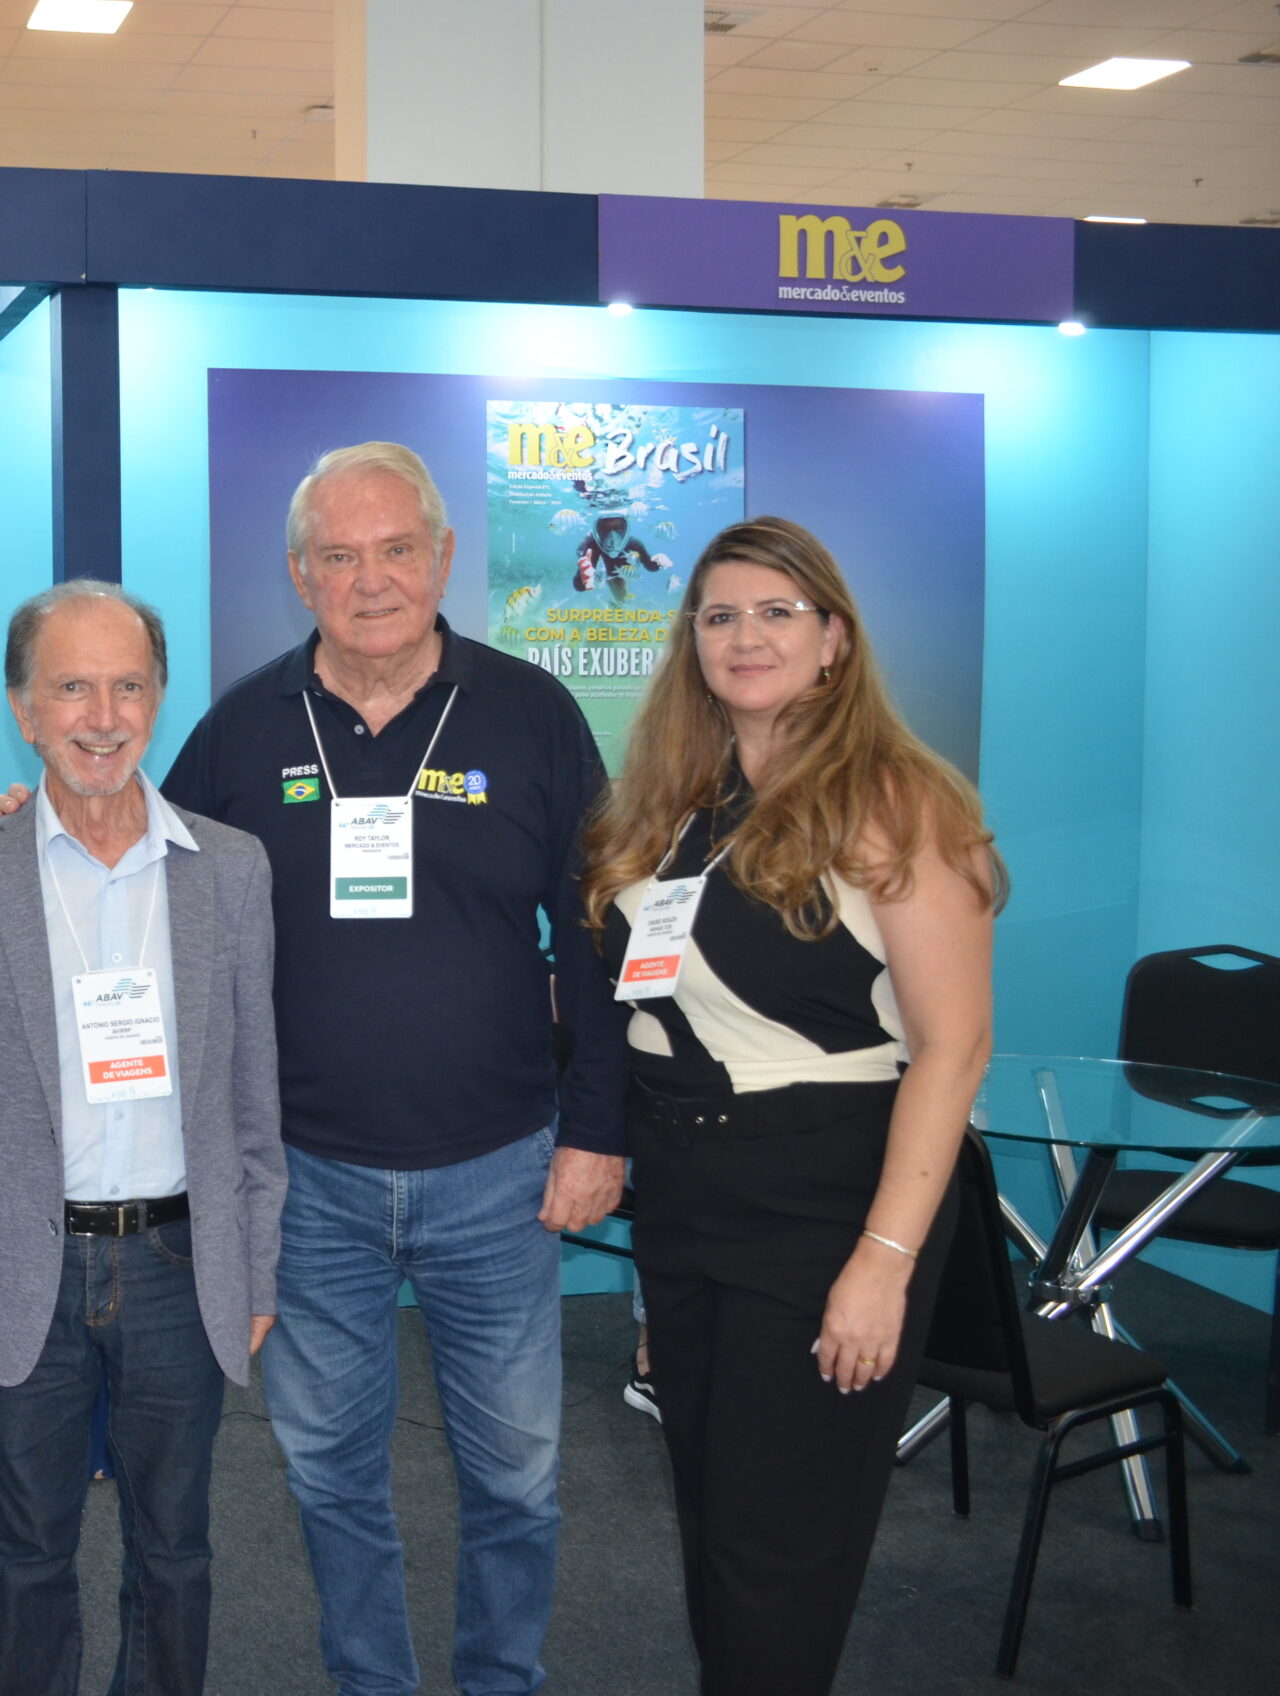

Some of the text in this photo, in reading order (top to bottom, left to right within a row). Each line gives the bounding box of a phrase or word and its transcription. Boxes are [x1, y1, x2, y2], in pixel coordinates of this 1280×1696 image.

[778, 214, 907, 283] m&e
[778, 285, 906, 304] mercado&eventos
[508, 424, 595, 468] m&e
[603, 424, 729, 482] Brasil
[508, 470, 594, 481] mercado&eventos
[547, 608, 677, 623] SURPREENDA-S
[525, 627, 565, 642] COM
[569, 628, 582, 642] A
[587, 628, 651, 642] BELEZA
[528, 643, 664, 676] PAÍS EXUBER
[282, 764, 319, 779] PRESS
[417, 768, 464, 795] m&e
[468, 775, 481, 786] 20
[351, 817, 377, 825] ABAV
[349, 884, 394, 893] EXPOSITOR
[96, 992, 124, 1002] ABAV
[82, 1016, 160, 1029] ANTONIO SERGIO IGNACIO
[110, 1059, 143, 1069] AGENTE
[103, 1067, 153, 1079] DE VIAGENS
